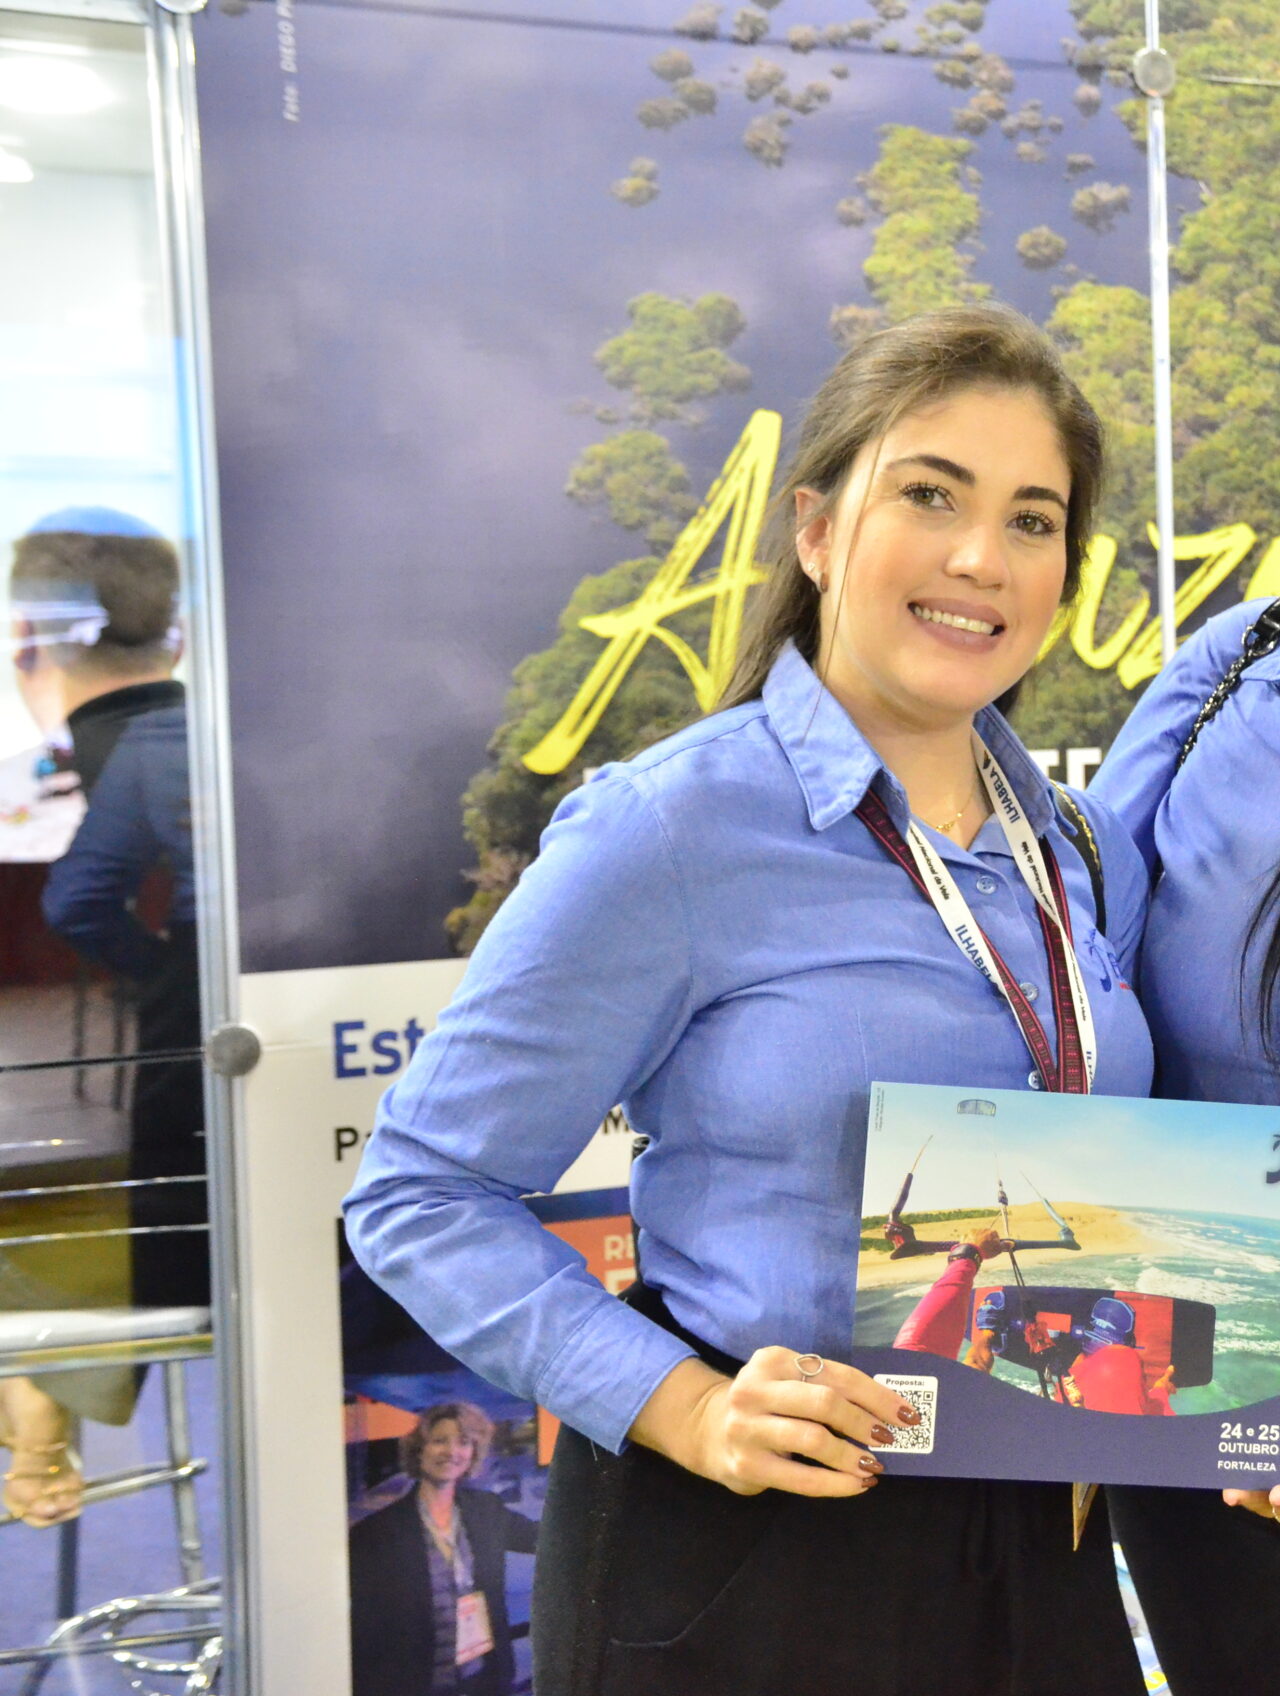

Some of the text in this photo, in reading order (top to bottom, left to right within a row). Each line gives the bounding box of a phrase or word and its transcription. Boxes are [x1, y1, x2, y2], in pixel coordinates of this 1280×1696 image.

[990, 766, 1021, 824] ILHABELA
[886, 1378, 925, 1387] Proposta:
[1220, 1422, 1280, 1441] 24 e 25
[1218, 1441, 1280, 1455] OUTUBRO
[1217, 1460, 1277, 1472] FORTALEZA
